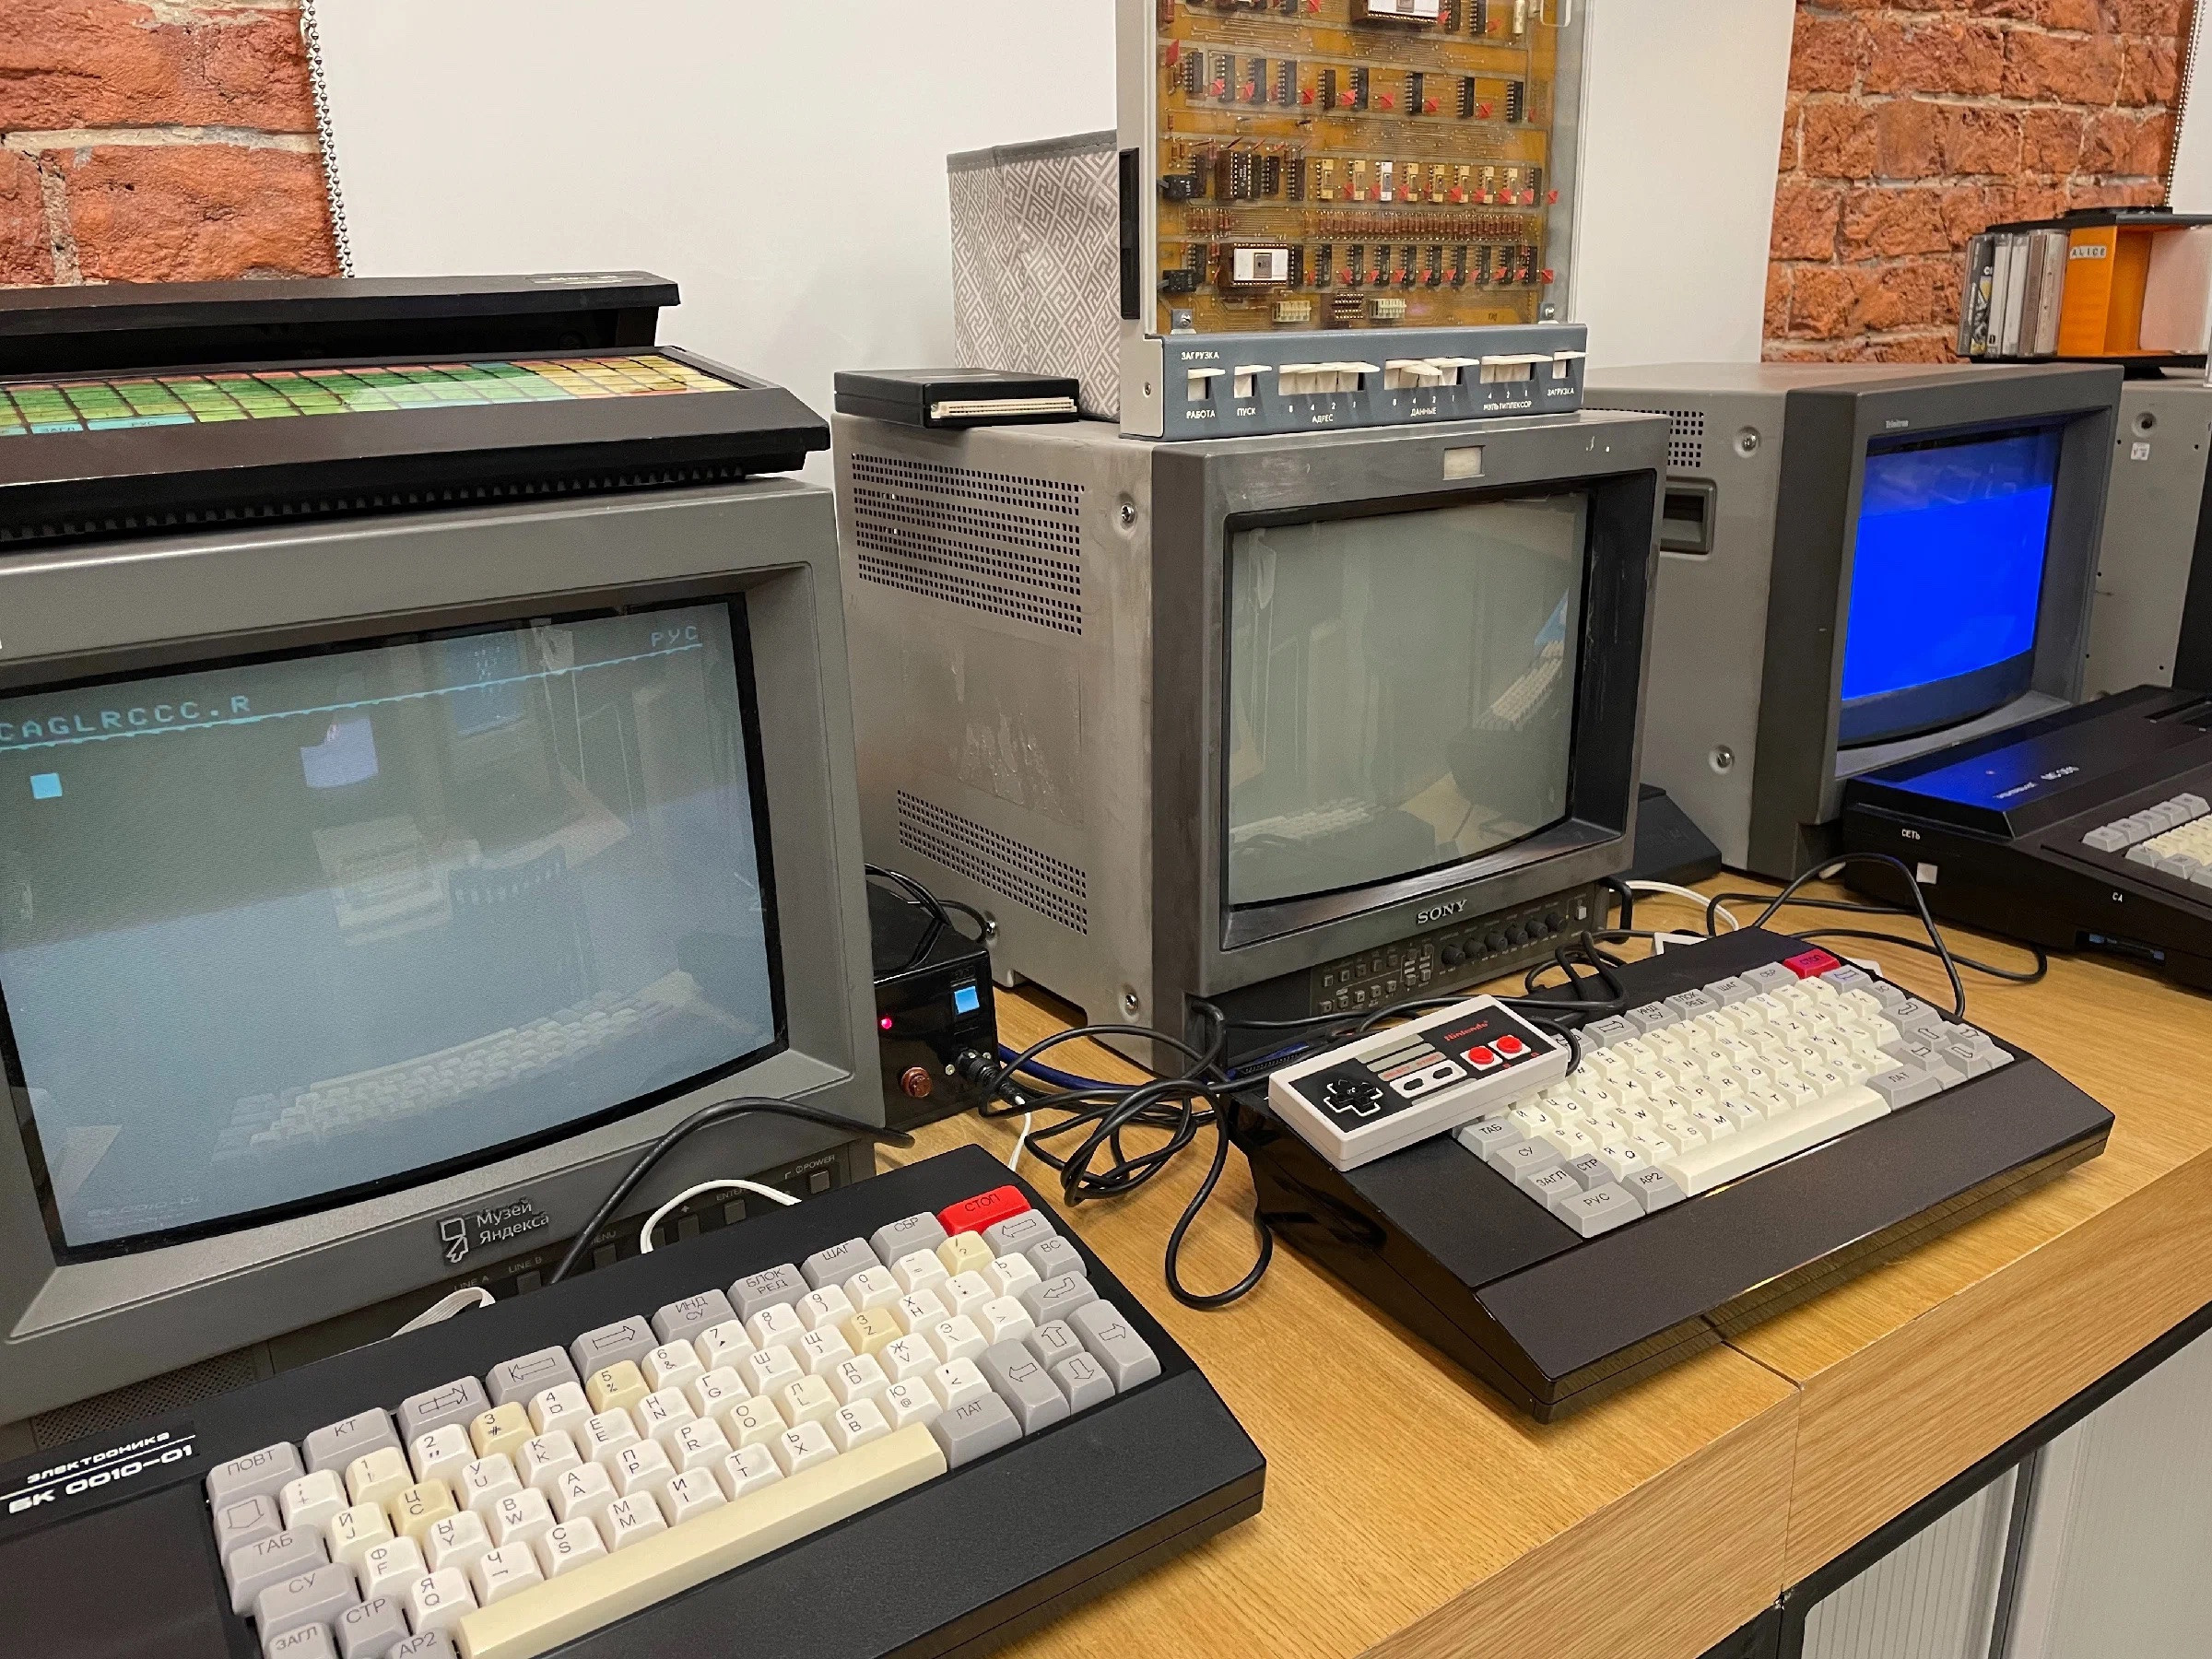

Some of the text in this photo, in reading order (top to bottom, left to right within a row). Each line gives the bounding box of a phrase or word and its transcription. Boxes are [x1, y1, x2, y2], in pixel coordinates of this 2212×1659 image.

[2072, 247, 2106, 257] ALICE
[1182, 352, 1219, 360] ЗАГРУЗКА
[1547, 388, 1575, 396] ЗАГРУЗКА
[1484, 401, 1532, 410] МУЛЬТИПЛЕКСОР
[1186, 410, 1216, 419] РАБОТА
[1237, 407, 1256, 417] ПУСК
[1410, 407, 1437, 417] ДАННЫЕ
[1312, 414, 1334, 423] АДРЕС
[651, 624, 699, 647] РУС
[1901, 829, 1921, 841] СЕТЬ
[1418, 899, 1467, 924] SONY
[1801, 955, 1821, 965] СТОП
[1760, 970, 1776, 978] СБР
[1717, 982, 1735, 992] ШАГ
[1673, 992, 1697, 1002] БЛОК
[1686, 998, 1707, 1006] РЕД
[1637, 1006, 1657, 1015] ИНД
[1443, 1020, 1488, 1041] Nintendo
[1888, 1073, 1910, 1082] ЛАТ
[1634, 1111, 1647, 1119] W
[1479, 1124, 1501, 1135] ТАБ
[1519, 1147, 1533, 1157] СУ
[803, 1155, 836, 1171] POWER
[1577, 1159, 1598, 1171] СТР
[1536, 1171, 1568, 1186] ЗАГЛ
[1640, 1172, 1664, 1185] АР2
[964, 1194, 1000, 1212] СТОП
[1583, 1193, 1609, 1207] РУС
[477, 1199, 532, 1228] Музей
[479, 1214, 549, 1244] Яндекса
[894, 1218, 919, 1232] СБР
[822, 1242, 849, 1261] ШАГ
[1041, 1241, 1062, 1253] ВС
[508, 1256, 542, 1273] LINE B
[746, 1268, 785, 1287] БЛОК
[758, 1280, 789, 1294] РЕД
[813, 1294, 821, 1302] 9
[676, 1297, 708, 1313] ИНД
[686, 1310, 703, 1321] СУ
[762, 1312, 771, 1321] 8
[710, 1328, 718, 1338] 7
[866, 1325, 877, 1335] Z
[939, 1324, 953, 1333] Э
[892, 1341, 909, 1354] Ж
[657, 1349, 667, 1359] 6
[754, 1352, 771, 1365] Ш
[900, 1353, 911, 1362] V
[842, 1363, 857, 1376] Д
[602, 1371, 611, 1382] 5
[849, 1374, 862, 1384] D
[709, 1388, 721, 1398] G
[791, 1383, 804, 1395] Л
[889, 1385, 906, 1397] Ю
[547, 1393, 555, 1401] 4
[796, 1398, 809, 1406] L
[653, 1409, 666, 1419] N
[841, 1409, 854, 1420] Б
[956, 1399, 982, 1419] ЛАТ
[485, 1414, 495, 1424] 3
[335, 1419, 357, 1437] КТ
[424, 1436, 436, 1448] 2
[787, 1433, 799, 1442] Ь
[687, 1440, 700, 1450] R
[623, 1450, 637, 1462] П
[228, 1450, 275, 1475] ПОВТ
[8, 1444, 193, 1514] БК 0010-01
[475, 1476, 488, 1488] U
[673, 1478, 687, 1491] И
[405, 1489, 420, 1503] Ц
[339, 1512, 354, 1526] Й
[506, 1511, 523, 1524] W
[438, 1520, 453, 1534] Ы
[253, 1533, 293, 1556] ТАБ
[442, 1535, 454, 1546] Y
[371, 1548, 387, 1559] Ф
[559, 1542, 571, 1554] S
[488, 1552, 502, 1564] Ч
[377, 1562, 388, 1575] F
[288, 1573, 315, 1594] СУ
[421, 1578, 435, 1593] Я
[347, 1598, 385, 1624] СТР
[276, 1626, 317, 1651] ЗАГЛ
[399, 1632, 437, 1658] АР2
